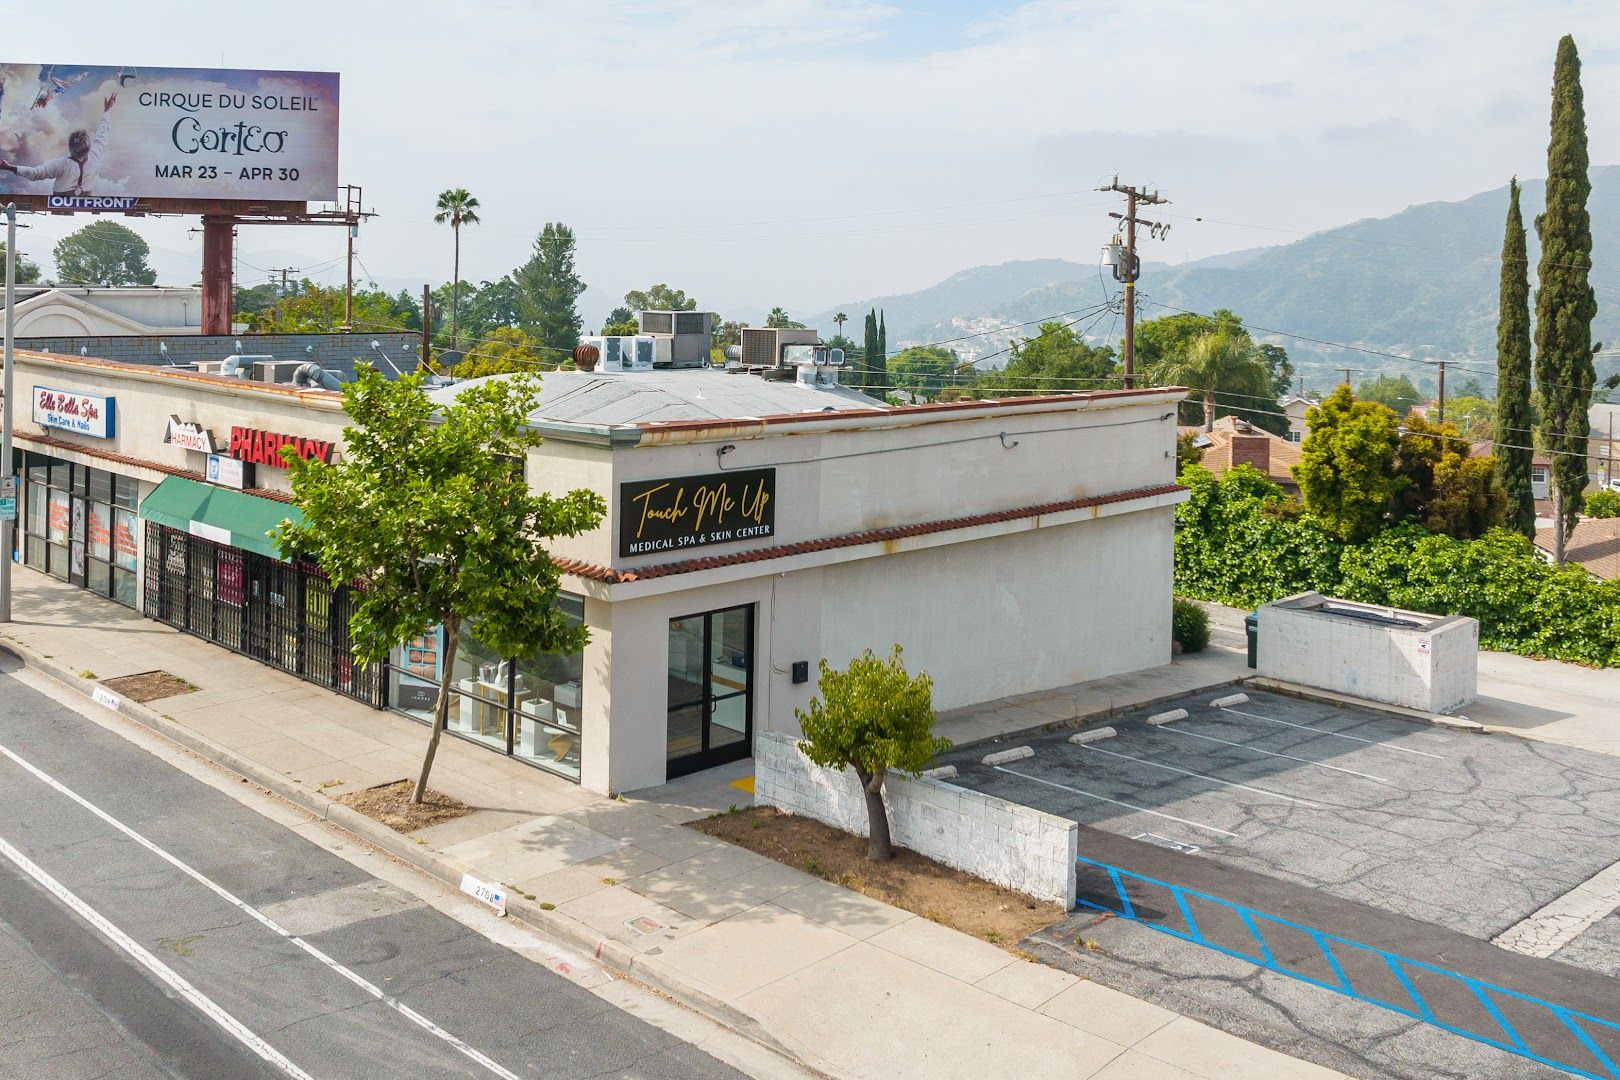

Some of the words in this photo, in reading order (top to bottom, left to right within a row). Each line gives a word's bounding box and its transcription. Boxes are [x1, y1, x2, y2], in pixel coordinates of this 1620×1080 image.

[139, 92, 212, 112] CIRQUE
[219, 94, 245, 109] DU
[251, 95, 318, 111] SOLEIL
[171, 116, 289, 156] Corteo
[155, 165, 193, 179] MAR
[198, 166, 218, 179] 23
[239, 167, 273, 181] APR
[279, 168, 300, 181] 30
[51, 196, 134, 209] OUTFRONT
[40, 391, 55, 410] Elle
[58, 394, 79, 414] Bella
[80, 399, 98, 421] Spa
[48, 413, 57, 423] Skin
[59, 416, 70, 426] Care
[72, 419, 75, 427] &
[77, 420, 90, 431] Nails
[169, 432, 206, 450] HARMACY
[230, 426, 328, 469] PHARMACY
[632, 482, 688, 539] Touch
[693, 482, 736, 532] Me
[741, 478, 770, 525] Up
[629, 538, 674, 553] MEDICAL
[678, 535, 696, 547] SPA
[699, 533, 707, 543] &
[710, 530, 732, 542] SKIN
[736, 524, 771, 538] CENTER
